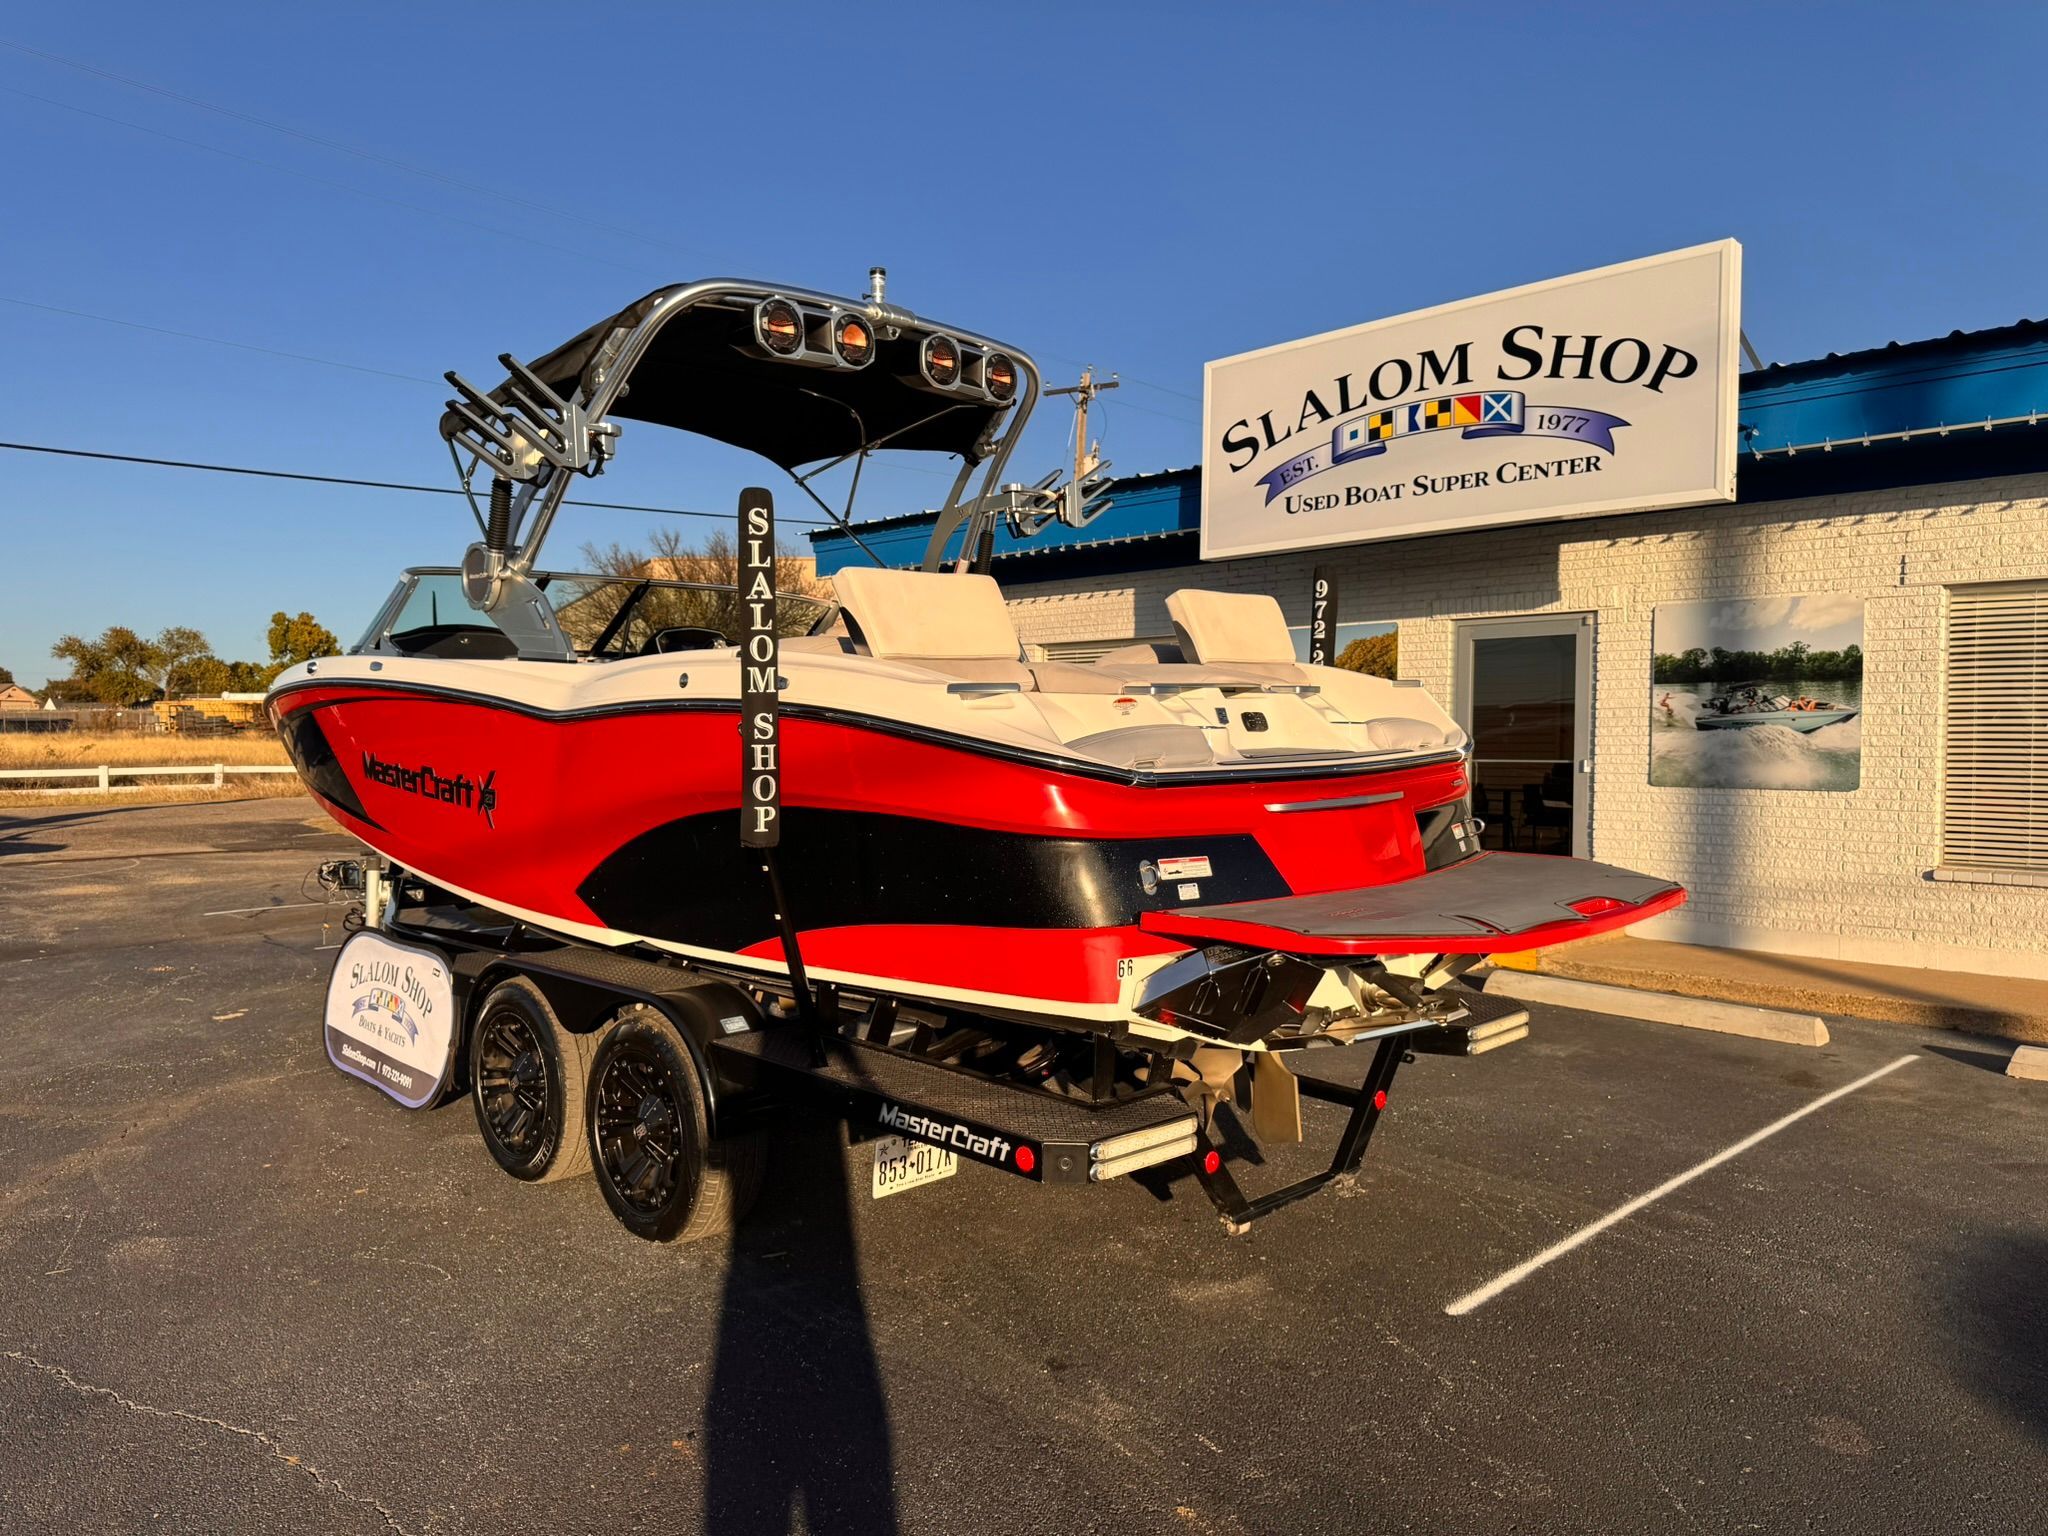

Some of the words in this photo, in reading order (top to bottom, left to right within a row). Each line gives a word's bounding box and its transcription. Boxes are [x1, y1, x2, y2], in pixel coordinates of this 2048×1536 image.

[1222, 342, 1474, 473] SLALOM
[1497, 325, 1699, 394] SHOP
[1537, 413, 1591, 435] 1977
[1280, 456, 1320, 486] EST.
[1285, 494, 1340, 515] USED
[1345, 484, 1405, 507] BOAT
[1412, 471, 1489, 496] SUPER
[1496, 456, 1602, 484] CENTER
[746, 507, 776, 693] SLALOM
[362, 750, 475, 808] MasterCraft
[751, 712, 776, 833] SHOP
[350, 961, 400, 989] SLALOM
[401, 966, 433, 1018] SHOP
[384, 1027, 406, 1047] YACHTS
[878, 1102, 1011, 1162] MasterCraft
[879, 1155, 907, 1186] 853
